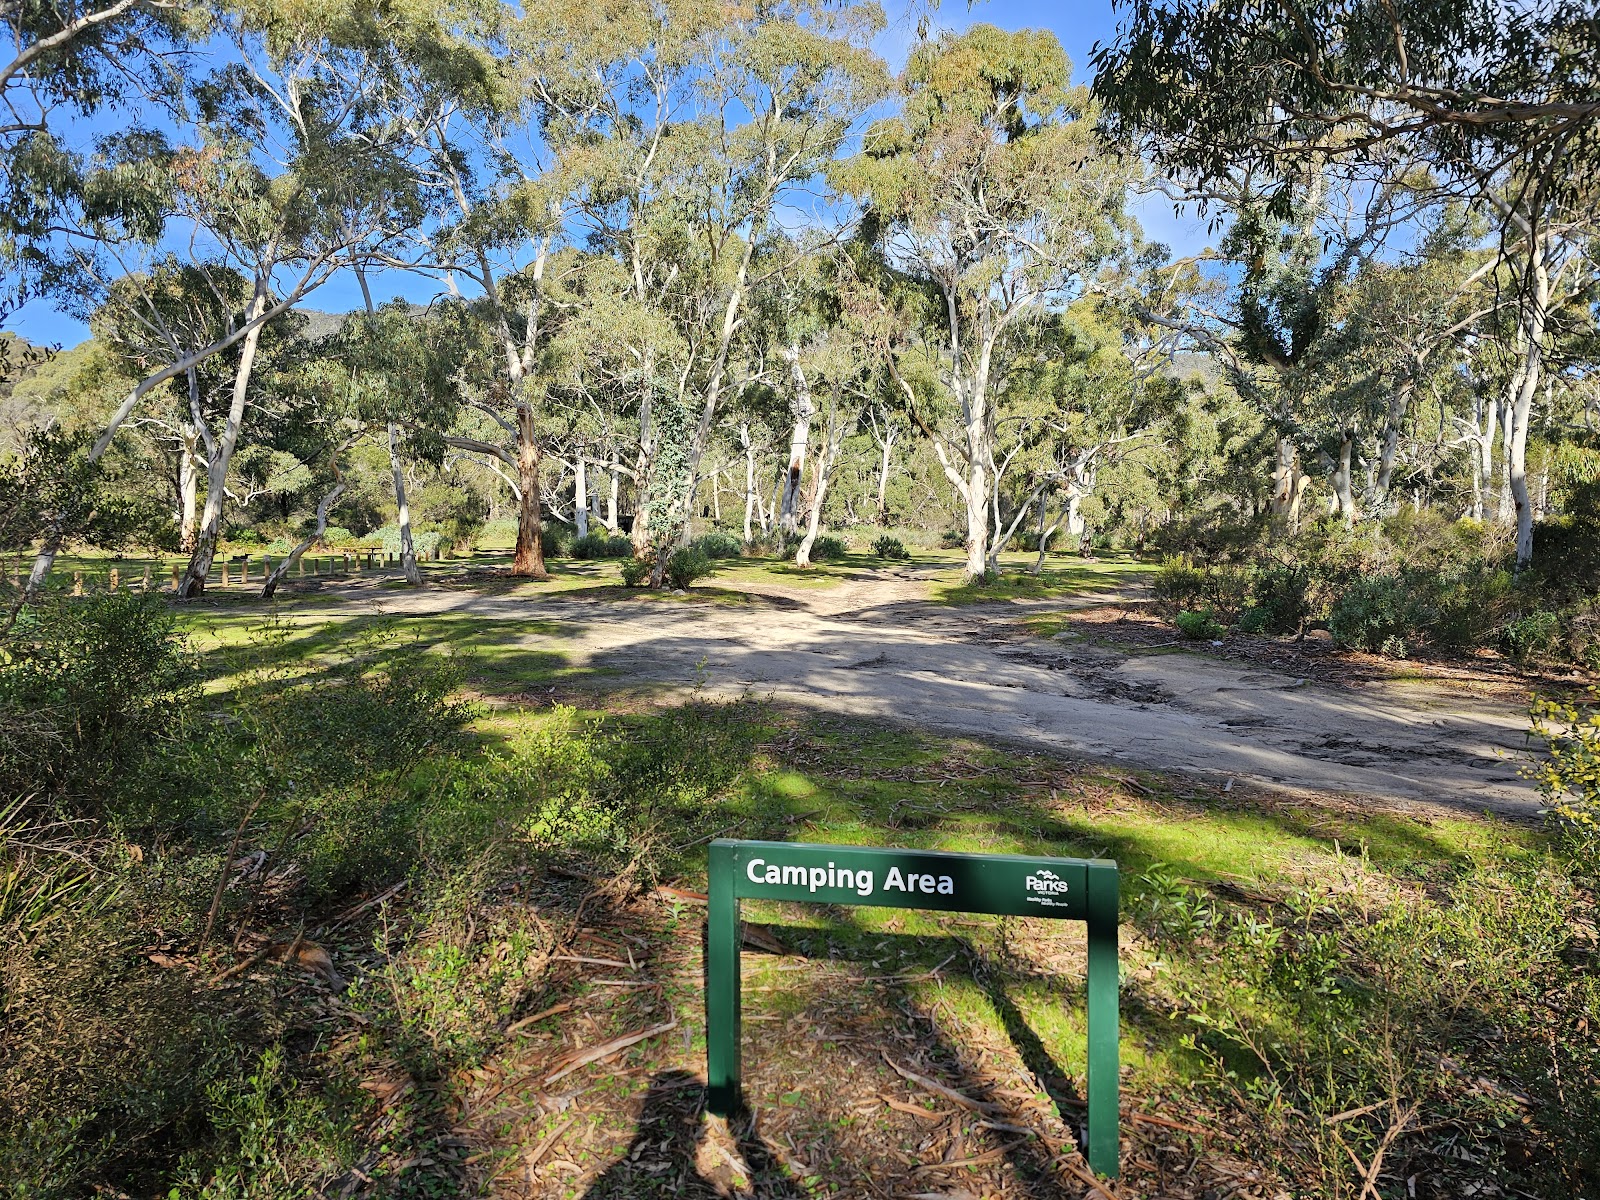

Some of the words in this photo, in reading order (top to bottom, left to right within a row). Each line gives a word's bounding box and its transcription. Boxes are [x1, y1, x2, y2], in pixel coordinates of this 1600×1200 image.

[746, 858, 874, 896] Camping
[884, 866, 954, 895] Area
[1025, 875, 1068, 893] Parks
